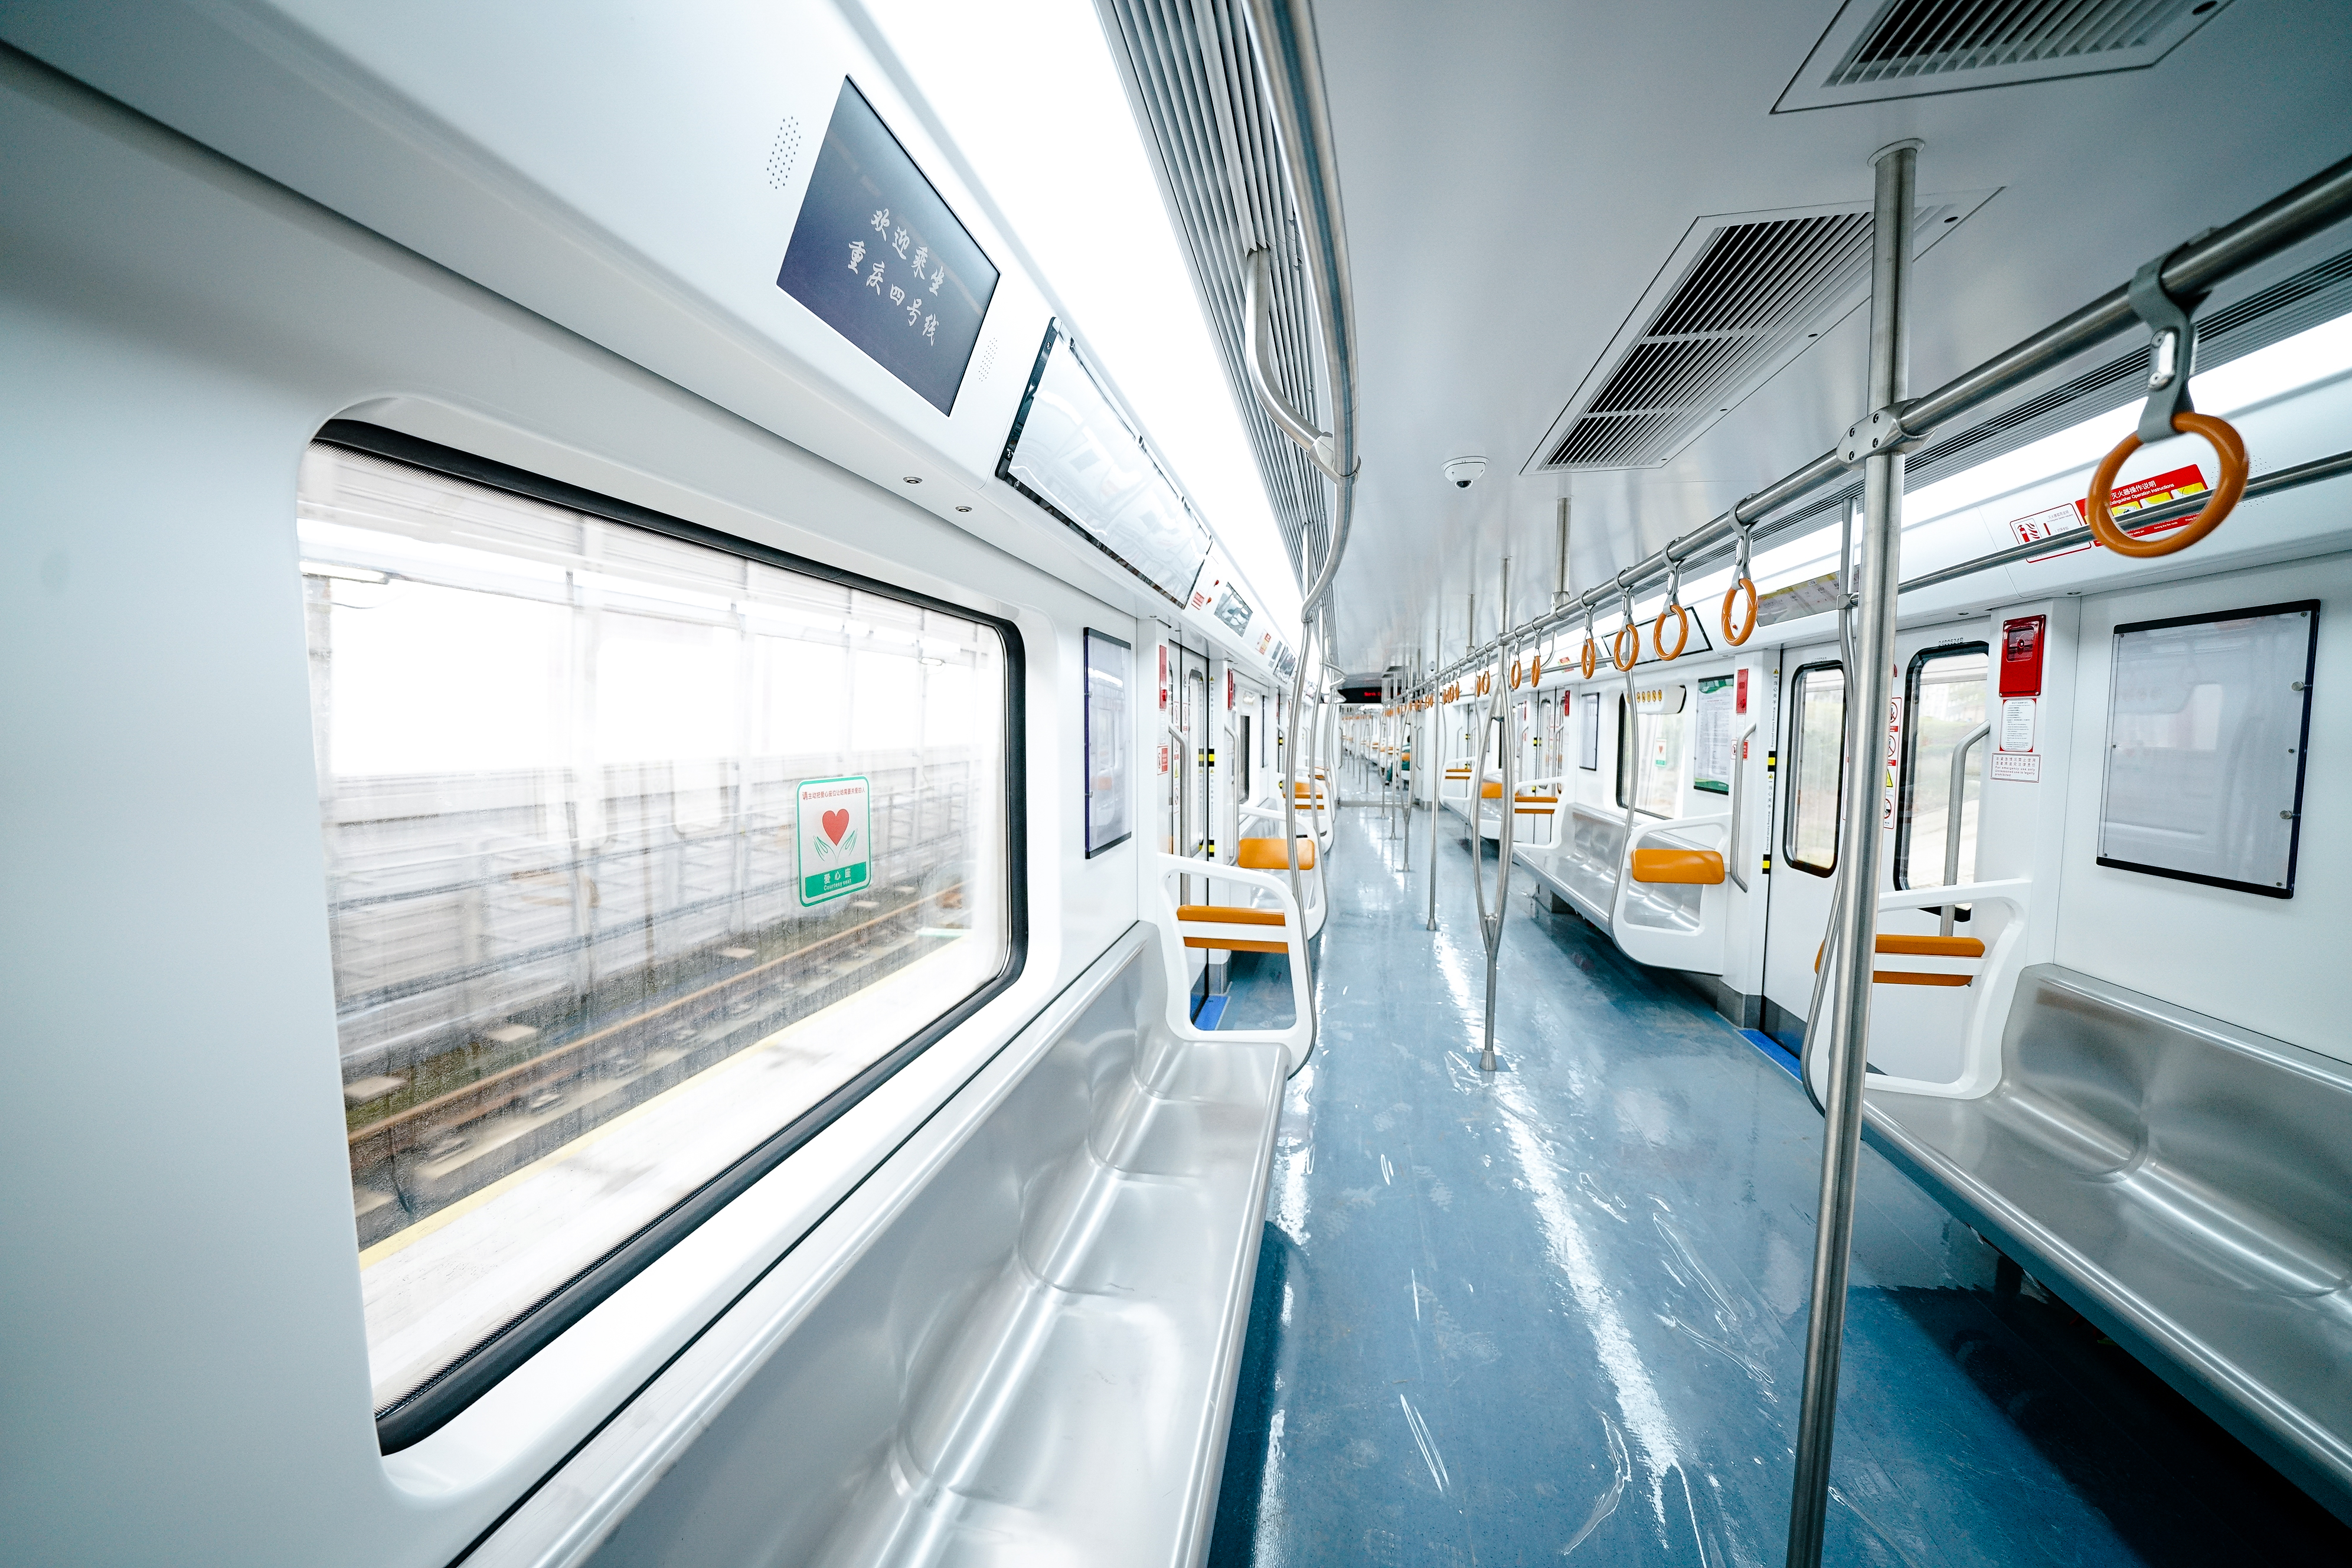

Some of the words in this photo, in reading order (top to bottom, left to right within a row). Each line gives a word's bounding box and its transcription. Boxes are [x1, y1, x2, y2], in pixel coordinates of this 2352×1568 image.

[871, 207, 943, 297] 欢迎乘坐
[848, 240, 939, 347] 重庆四号线
[2111, 480, 2157, 499] 灭火器操作说明
[2131, 490, 2151, 499] Operation
[2151, 484, 2175, 493] Instructions
[824, 867, 852, 884] 爱心座
[824, 881, 842, 891] Courtesy
